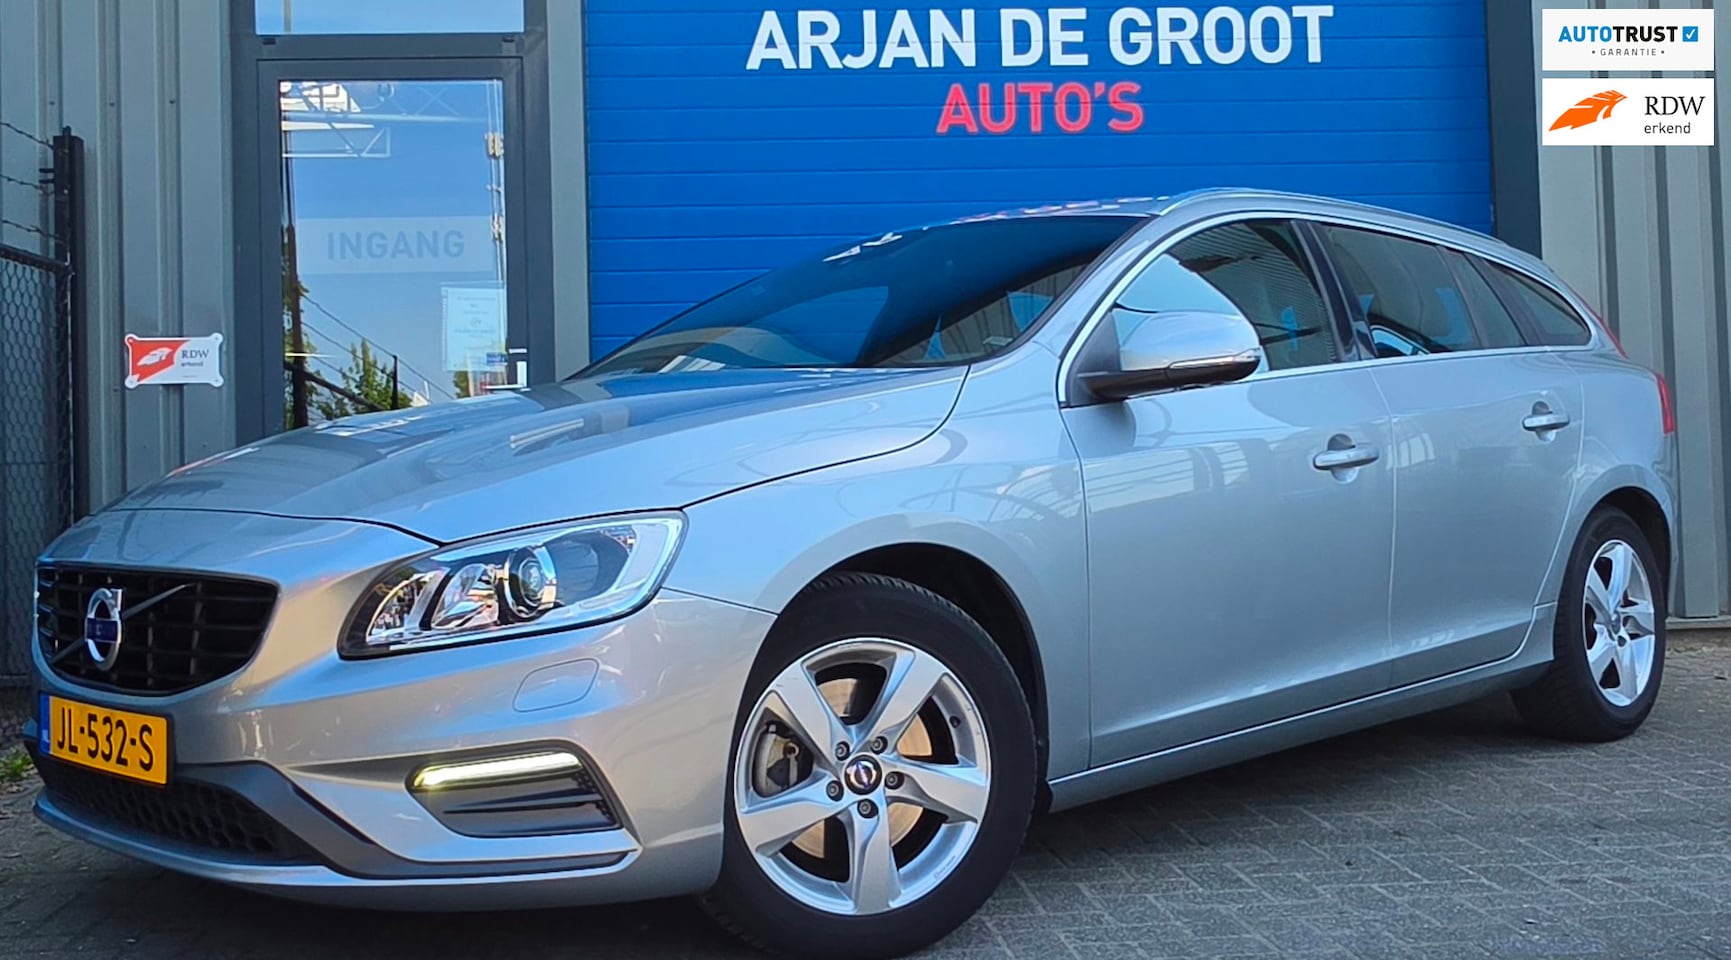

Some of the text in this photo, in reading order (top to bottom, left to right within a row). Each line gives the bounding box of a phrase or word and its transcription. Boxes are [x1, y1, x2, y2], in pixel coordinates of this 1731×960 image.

[746, 5, 1334, 70] ARJAN DE GROOT
[936, 81, 1144, 134] AUTO'S
[327, 230, 465, 261] INGANG
[181, 349, 210, 359] RDW
[56, 706, 154, 772] JL-532-S
